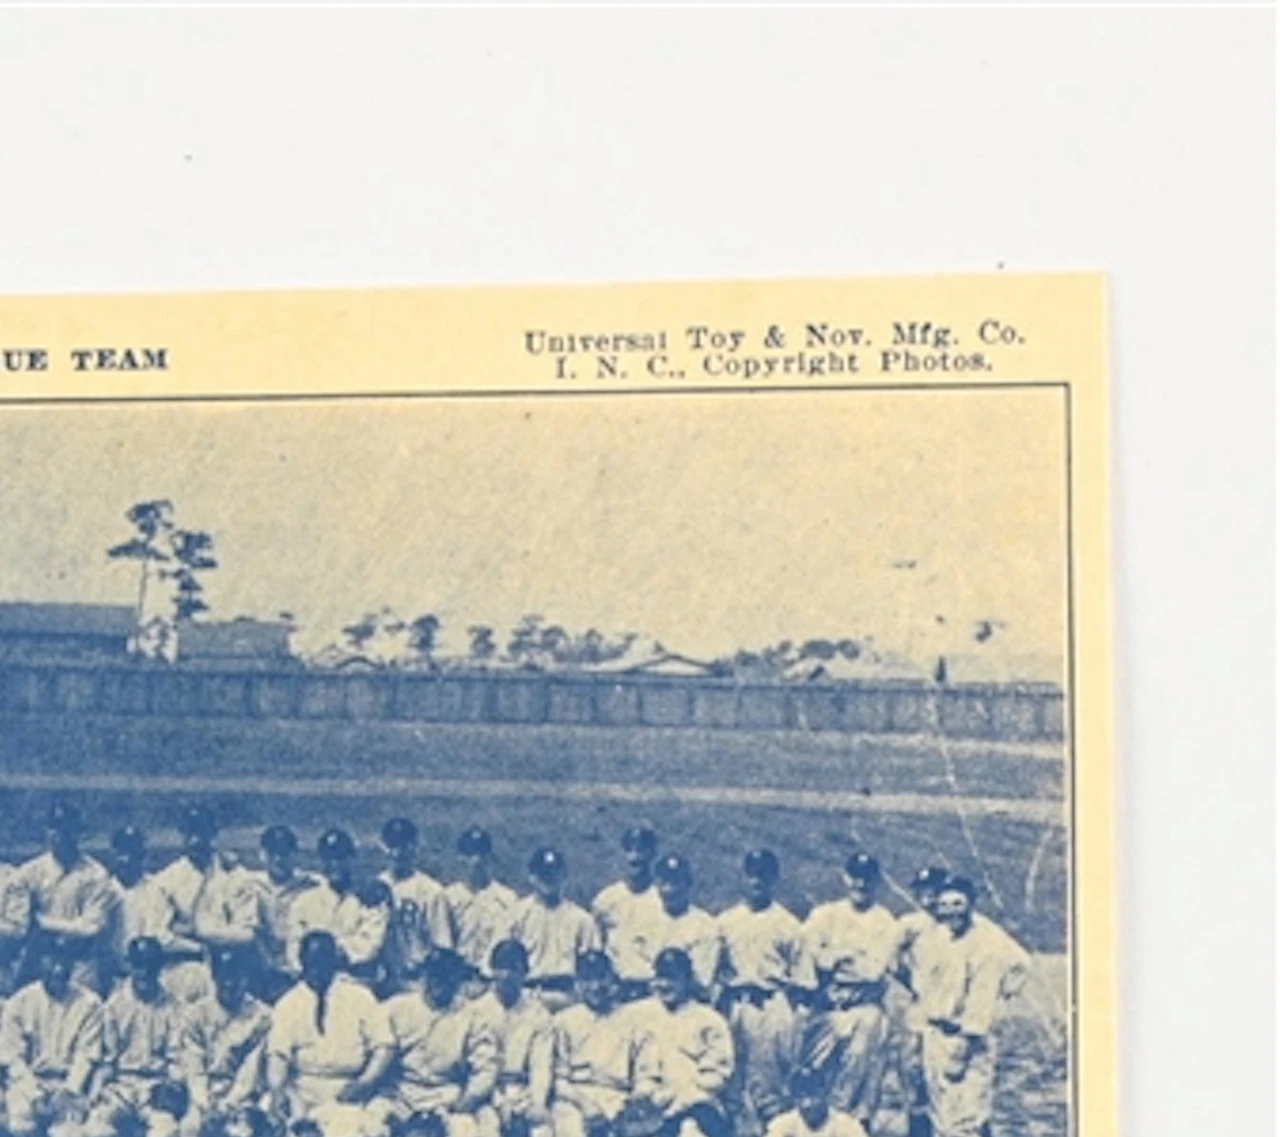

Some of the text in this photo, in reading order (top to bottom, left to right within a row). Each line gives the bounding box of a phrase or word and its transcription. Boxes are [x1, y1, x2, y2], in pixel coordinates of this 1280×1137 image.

[524, 319, 1025, 354] Universal Toy & Nov. Mfg. Co.
[70, 348, 168, 372] TEAM
[556, 346, 993, 380] I. N. C., Copyright Photos.
